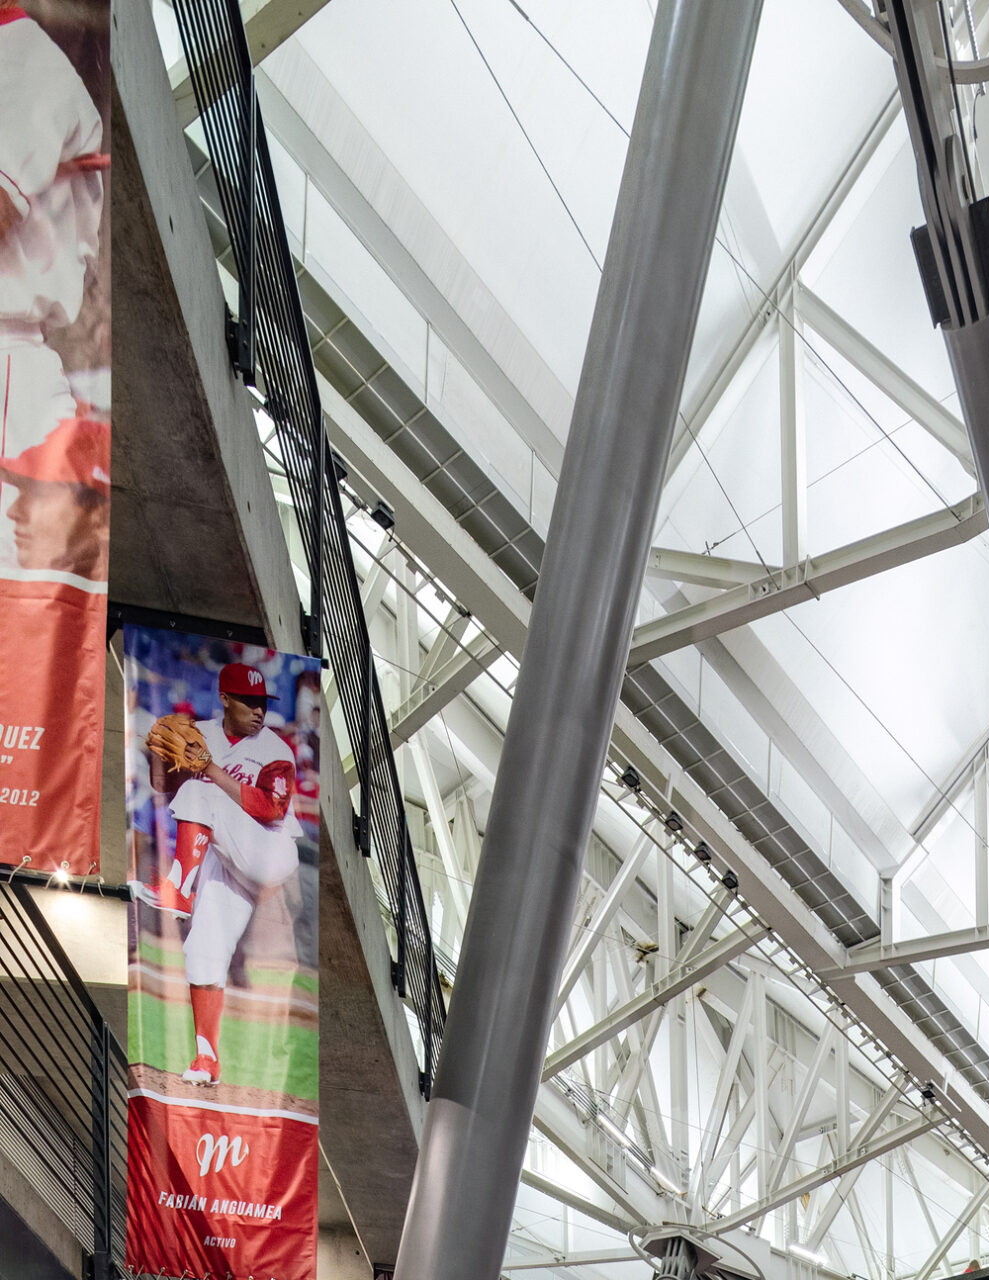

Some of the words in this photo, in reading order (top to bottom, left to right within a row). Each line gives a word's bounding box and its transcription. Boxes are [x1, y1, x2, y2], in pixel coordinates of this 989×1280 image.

[0, 787, 40, 807] 2012
[158, 1191, 208, 1212] FABIÁN
[210, 1199, 282, 1220] ANGUAMEA
[203, 1235, 236, 1248] ACTIVO
